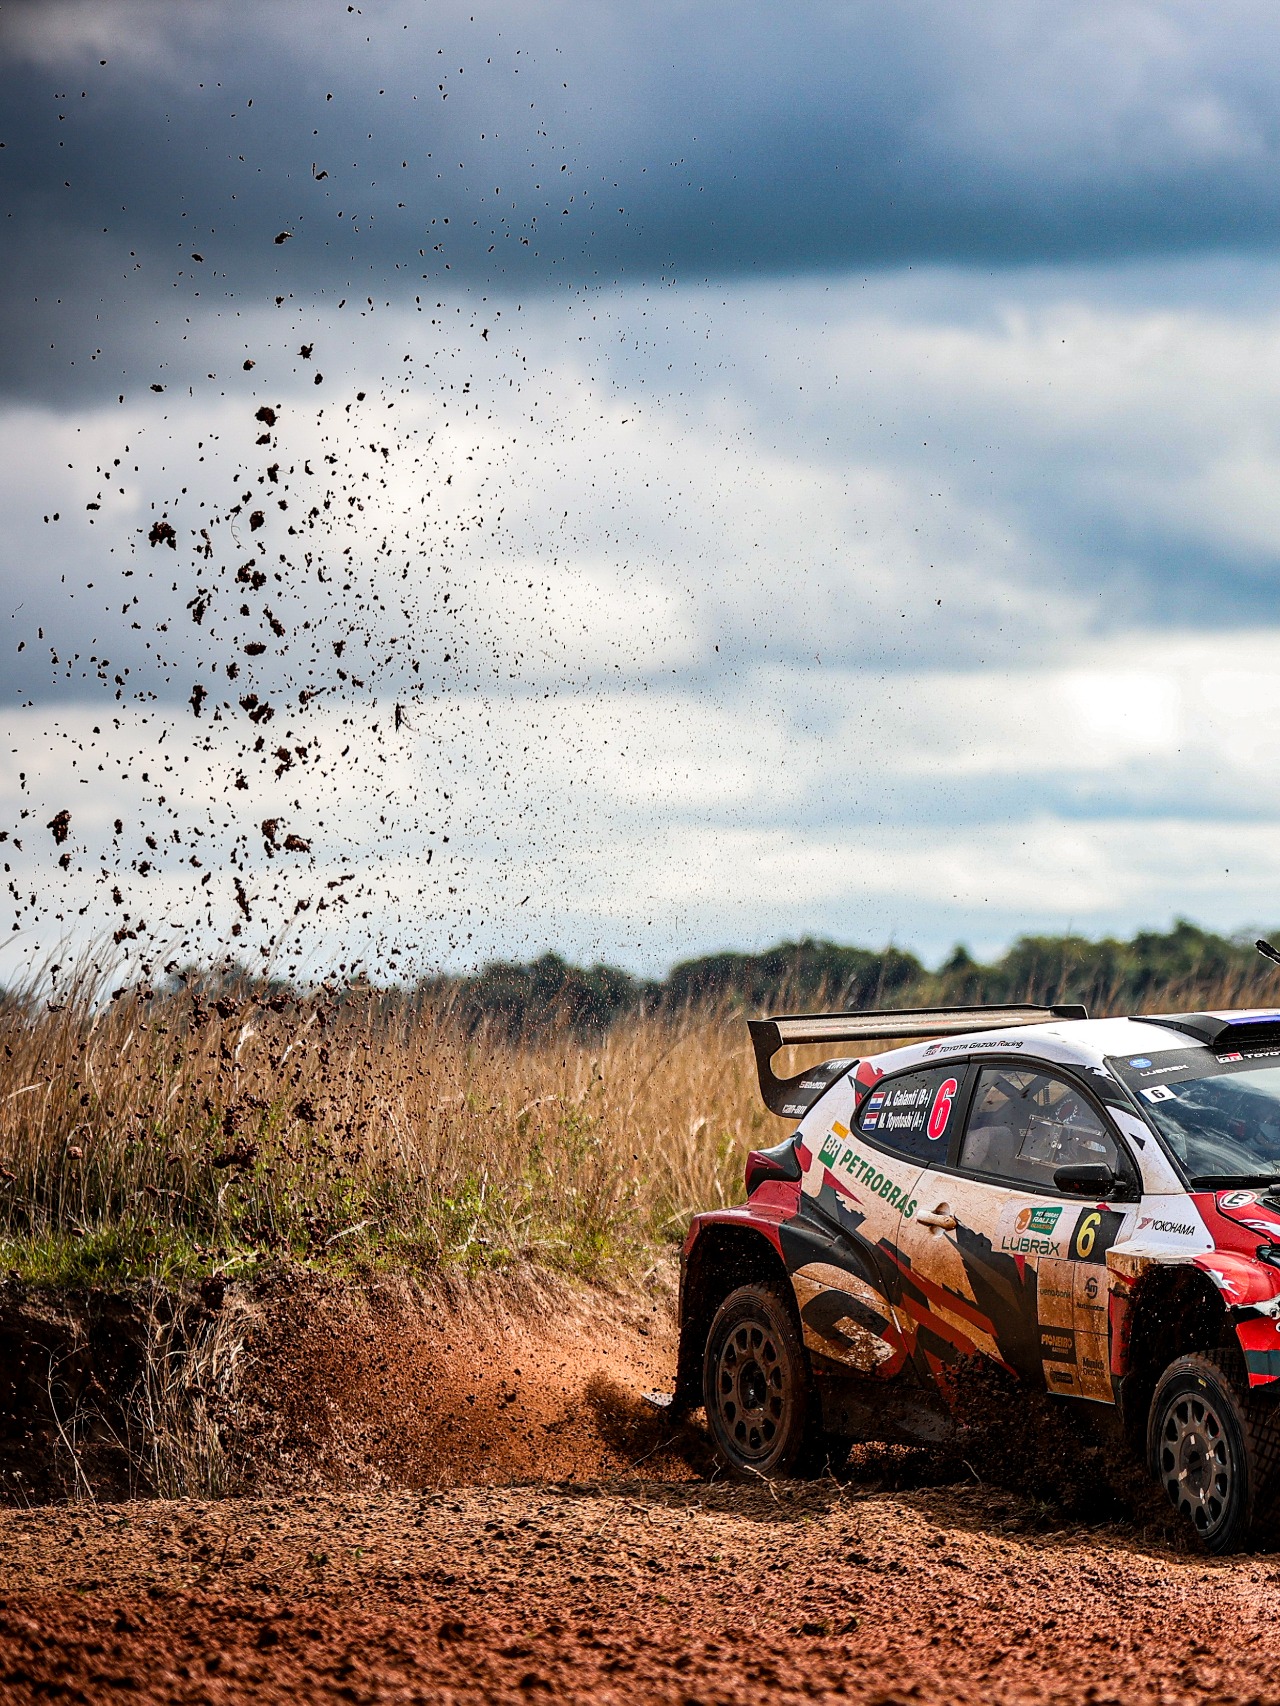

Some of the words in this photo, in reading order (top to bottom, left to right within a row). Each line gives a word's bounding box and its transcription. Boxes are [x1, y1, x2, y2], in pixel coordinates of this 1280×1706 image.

[939, 1044, 968, 1053] TOYOTA
[997, 1041, 1024, 1049] Racing
[884, 1091, 892, 1107] A.
[893, 1089, 919, 1107] Galanti
[914, 1089, 933, 1108] (B+)
[1151, 1089, 1166, 1099] 6
[927, 1078, 958, 1140] 6
[822, 1137, 842, 1159] BR
[838, 1149, 918, 1218] PETROBRAS
[1032, 1217, 1056, 1225] RALLY
[1151, 1219, 1196, 1236] YOKOHAMA
[1076, 1212, 1102, 1258] 6
